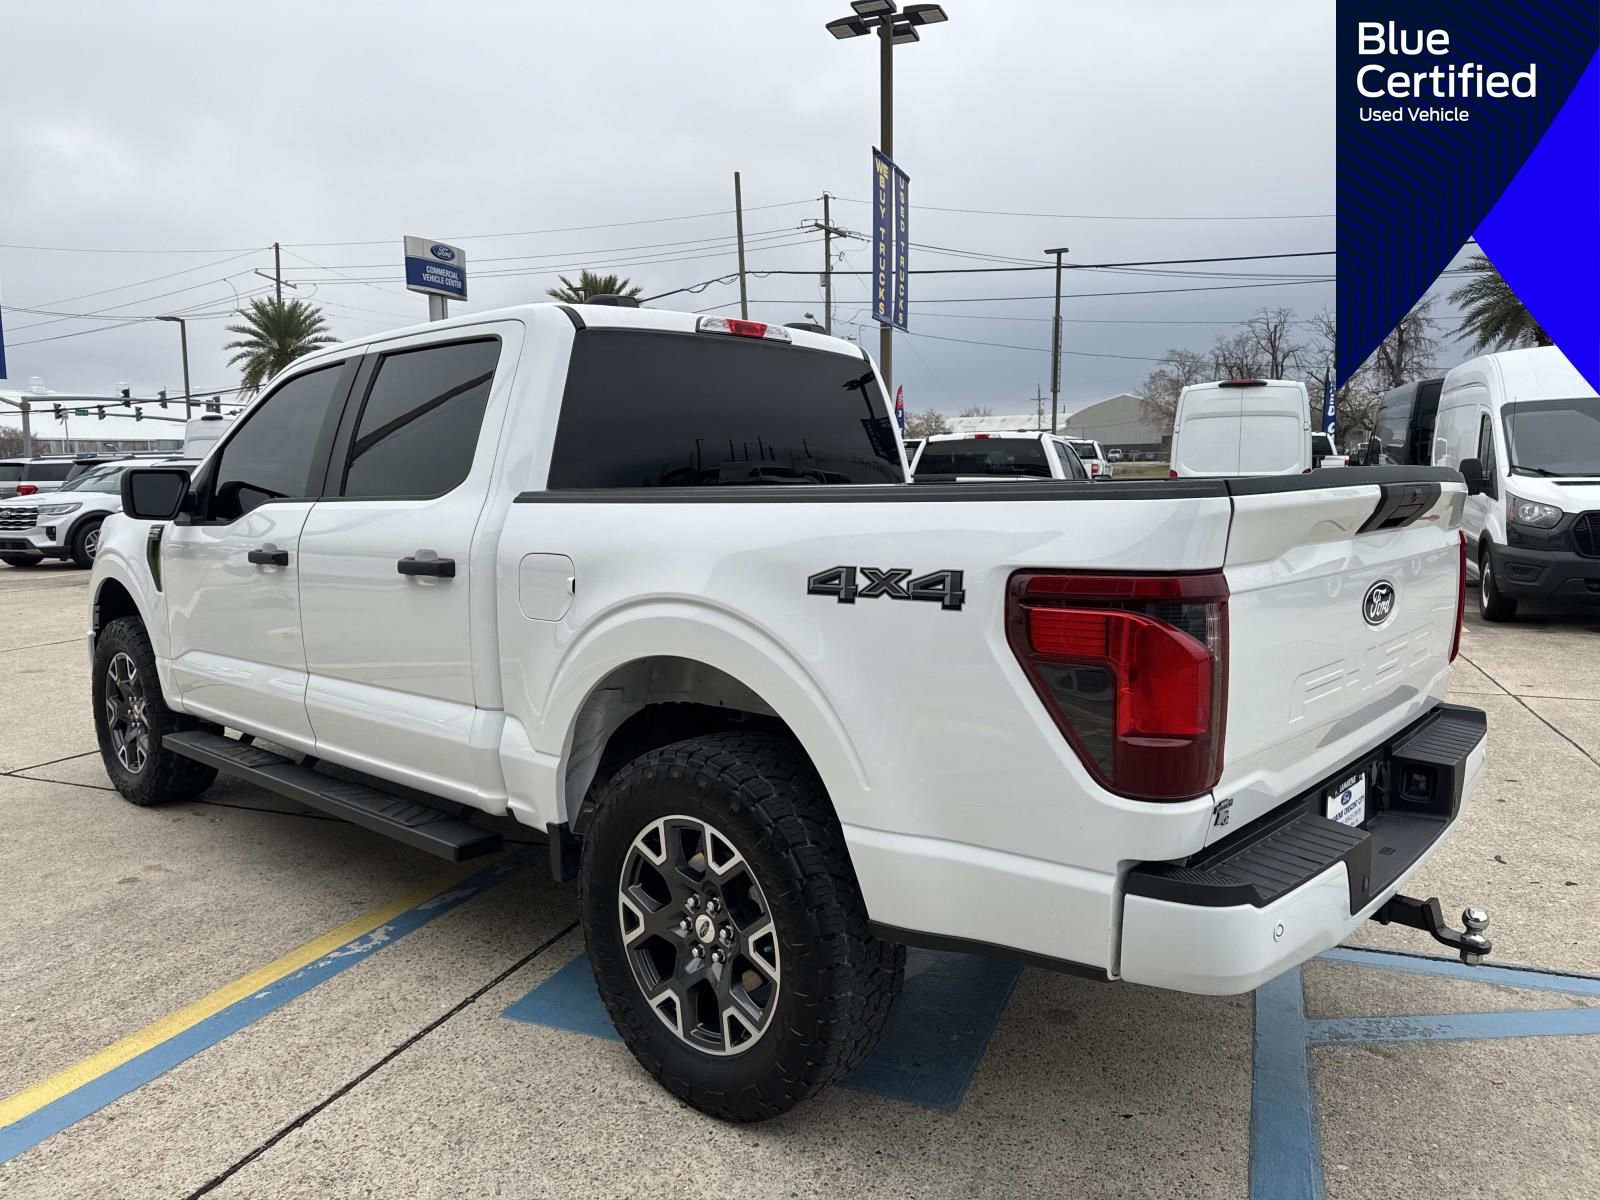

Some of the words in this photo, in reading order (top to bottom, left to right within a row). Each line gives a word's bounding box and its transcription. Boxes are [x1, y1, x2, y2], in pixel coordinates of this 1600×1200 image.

[875, 157, 889, 180] WE
[422, 272, 445, 285] VEHICLE
[445, 277, 462, 289] CENTER
[426, 265, 459, 280] COMMERCIAL
[1370, 588, 1392, 618] Ford
